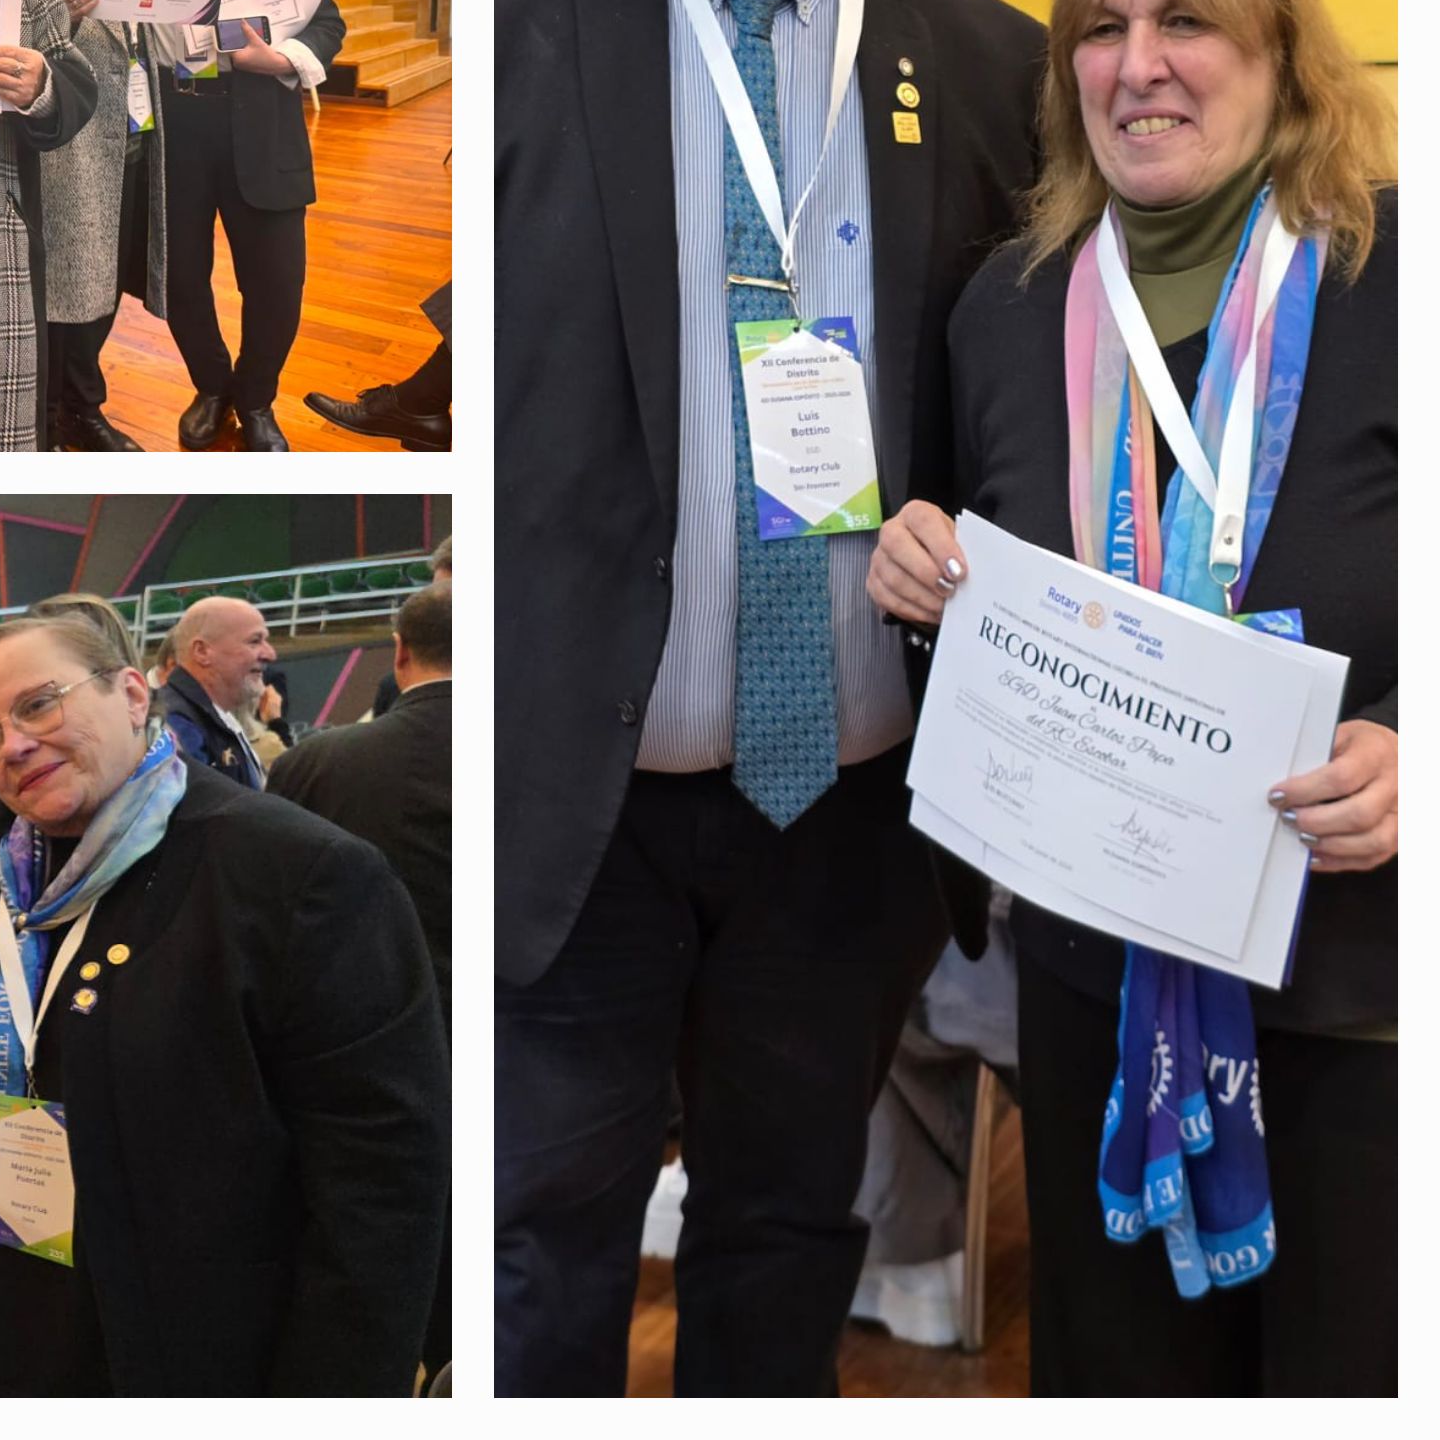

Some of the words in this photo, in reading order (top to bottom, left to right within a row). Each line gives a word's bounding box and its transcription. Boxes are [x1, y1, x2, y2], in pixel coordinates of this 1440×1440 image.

[775, 356, 827, 367] Conferencia
[829, 354, 839, 362] de
[786, 369, 819, 378] Distrito
[798, 409, 819, 421] Luis
[791, 426, 830, 437] Bottino
[789, 464, 819, 474] Rotary
[821, 462, 840, 471] Club
[1047, 586, 1082, 614] Rotary
[1113, 610, 1142, 627] UNIDOS
[979, 615, 1232, 754] RECONOCIMIENTO
[1040, 694, 1076, 723] Juan
[1079, 712, 1126, 746] Carlos
[1074, 735, 1128, 769] Escobar
